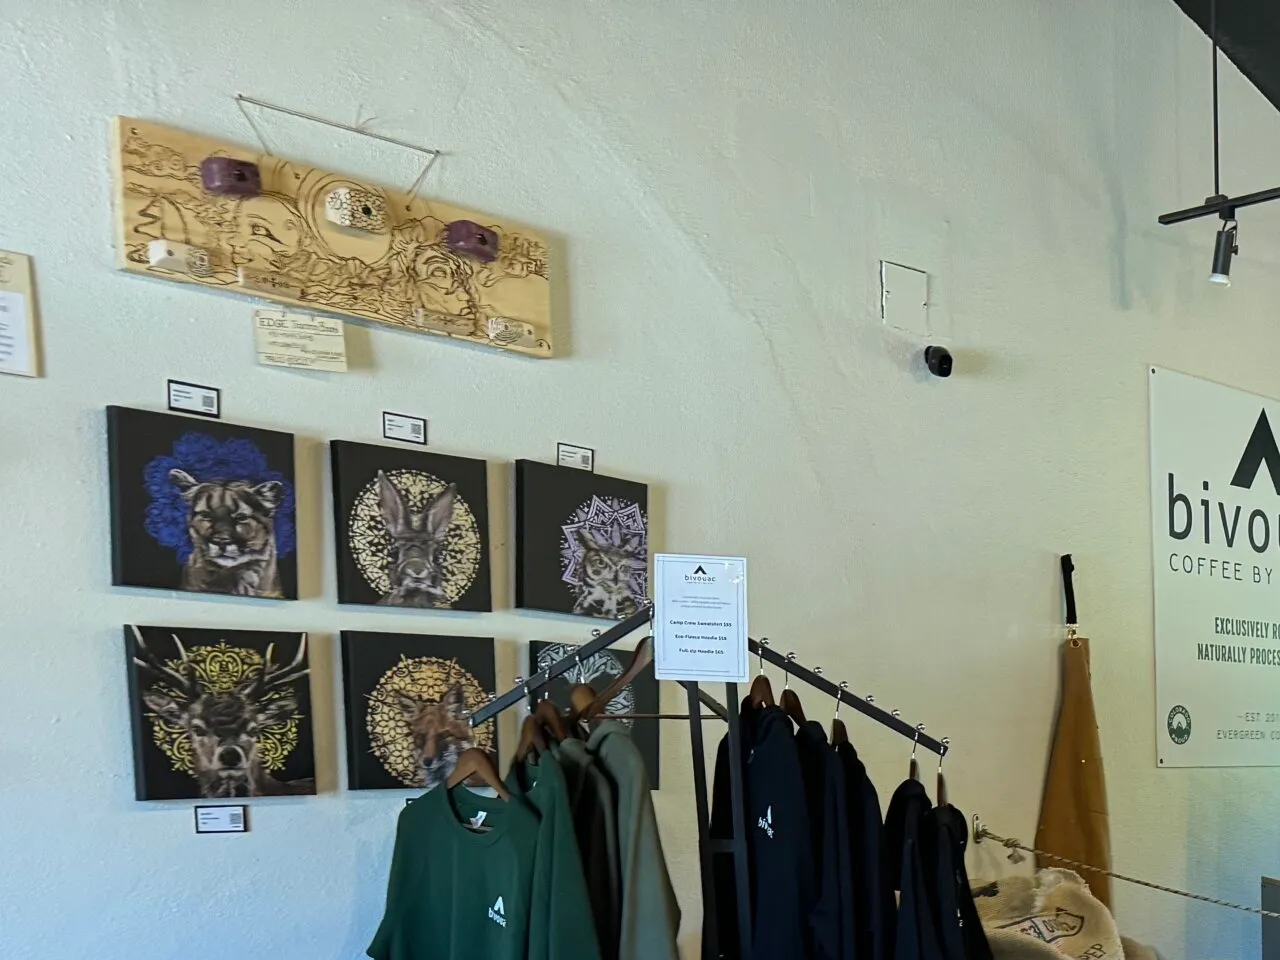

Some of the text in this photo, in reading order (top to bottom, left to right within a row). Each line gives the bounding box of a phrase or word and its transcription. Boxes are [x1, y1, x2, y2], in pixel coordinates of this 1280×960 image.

[684, 574, 716, 582] bivouac
[1169, 553, 1243, 581] COFFEE
[1252, 566, 1273, 585] BY
[1214, 617, 1270, 639] EXCLUSIVELY
[1197, 643, 1247, 663] NATURALLY
